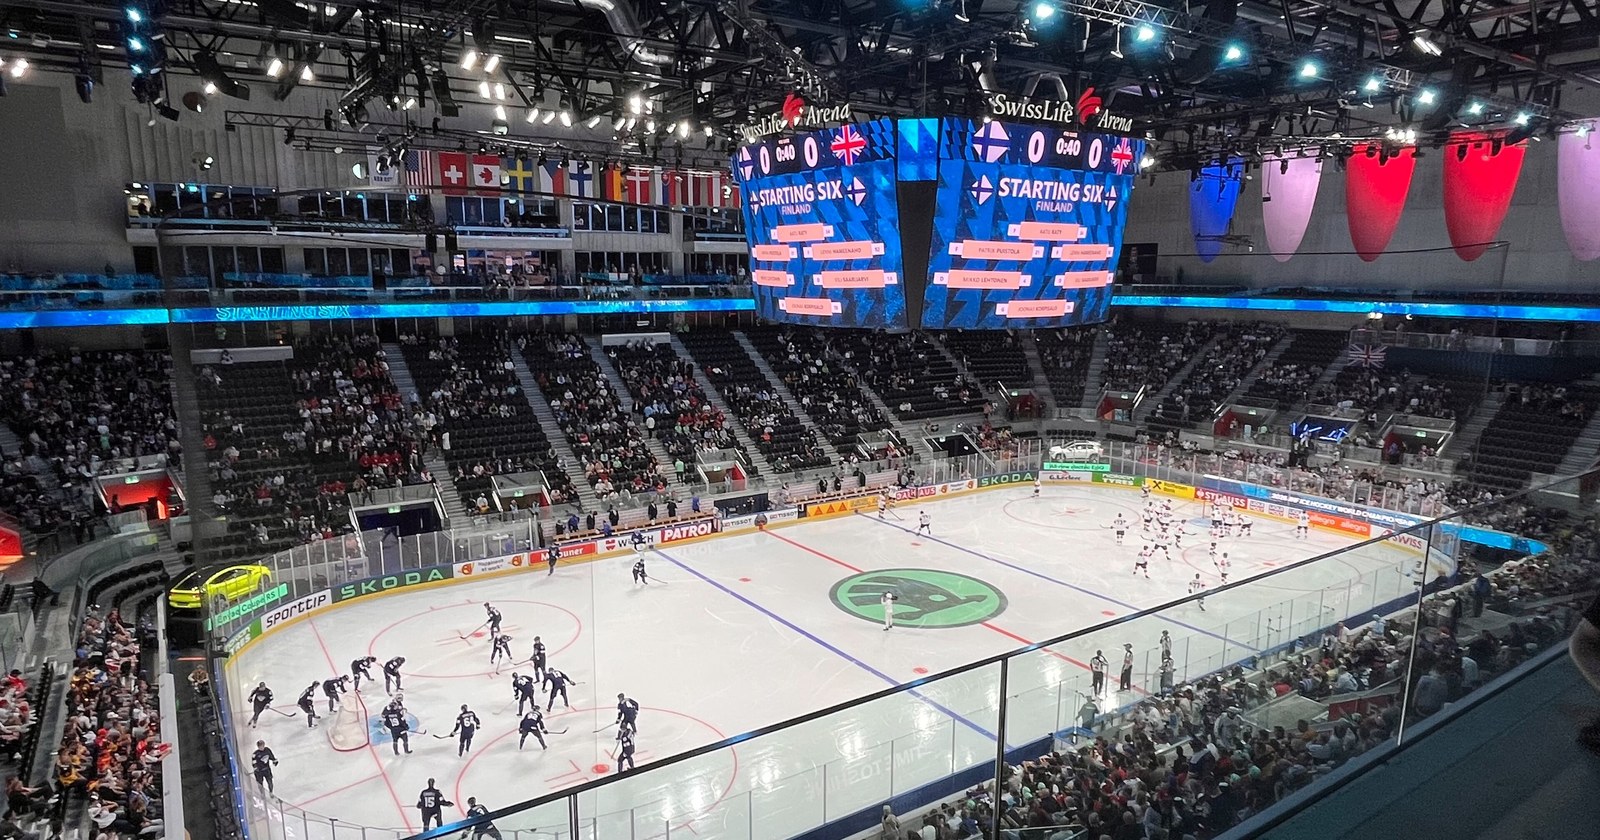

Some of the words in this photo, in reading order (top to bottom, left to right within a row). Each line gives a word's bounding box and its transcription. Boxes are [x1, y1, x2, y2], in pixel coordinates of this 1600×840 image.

[806, 103, 851, 126] Arena
[993, 94, 1074, 123] SwissLife
[1097, 109, 1133, 132] Arena
[776, 144, 795, 162] 0:40
[804, 137, 818, 167] 0
[1028, 131, 1045, 163] 0
[1056, 137, 1081, 156] 0:40
[1088, 138, 1102, 169] 0
[760, 145, 770, 174] 0
[760, 183, 814, 207] STARTING
[817, 180, 843, 200] SIX
[998, 177, 1080, 201] STARTING
[1082, 185, 1104, 203] SIX
[781, 203, 811, 215] FINLAND
[1036, 201, 1073, 212] FINLAND
[216, 306, 316, 321] STARTING
[318, 305, 350, 318] SIX
[778, 510, 799, 518] TISSOT
[1311, 500, 1337, 511] HOCKEY
[1337, 506, 1361, 516] WORLD
[731, 518, 752, 526] TISSOT
[1310, 514, 1336, 526] allegro
[1340, 520, 1368, 532] allegro
[1192, 580, 1200, 588] 77
[266, 592, 276, 600] RS
[390, 717, 400, 727] 19
[424, 796, 435, 808] 15
